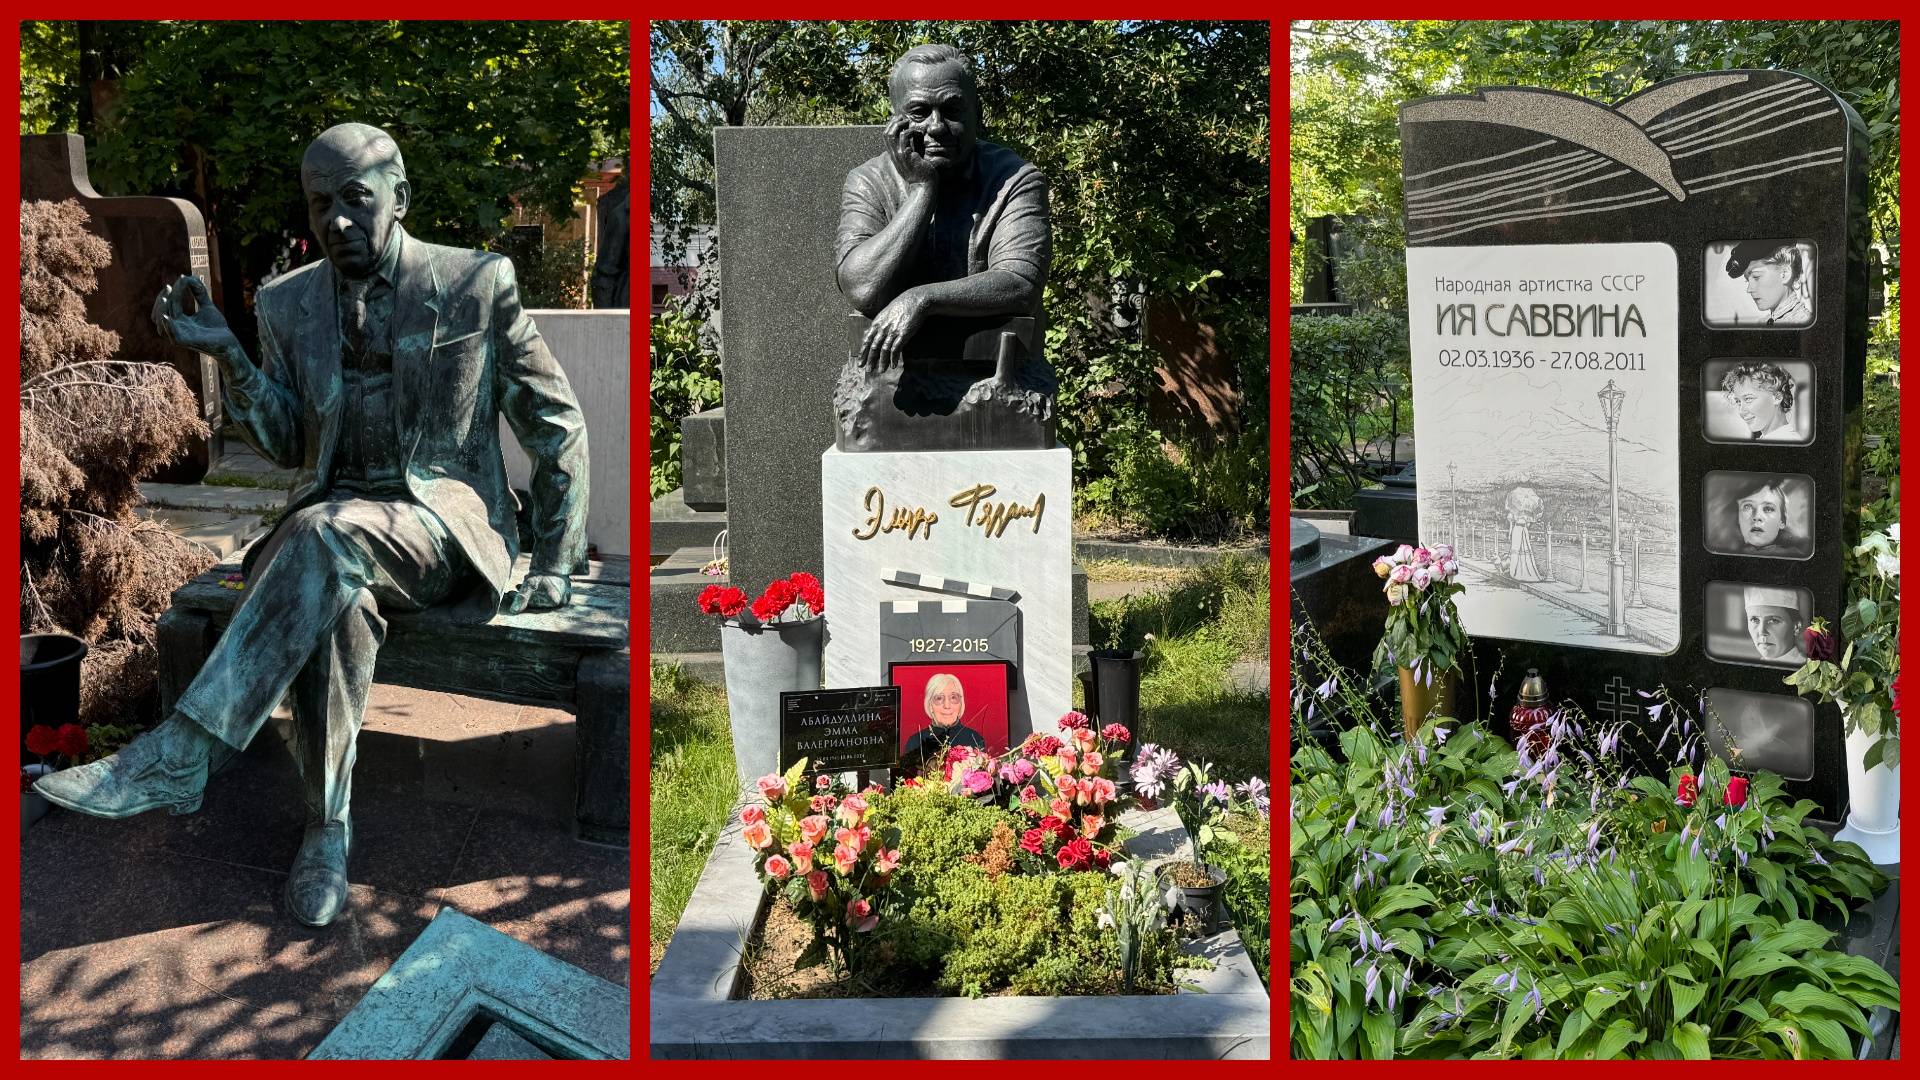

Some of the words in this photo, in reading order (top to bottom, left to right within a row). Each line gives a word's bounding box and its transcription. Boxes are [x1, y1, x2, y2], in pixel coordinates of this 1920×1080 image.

[1435, 276, 1511, 295] Народная
[1519, 279, 1592, 295] артистка
[1601, 275, 1645, 291] СССР
[1436, 303, 1476, 336] ИЯ
[1484, 303, 1647, 337] САВВИНА
[1439, 349, 1535, 368] 02.03.1936
[1550, 351, 1646, 371] 27.08.2011
[909, 638, 989, 653] 1927-2015
[800, 712, 882, 726] АБАЙДУЛЛИНА
[823, 726, 858, 737] ЭММА
[797, 735, 885, 750] ВАЛЕРИАНОВНА
